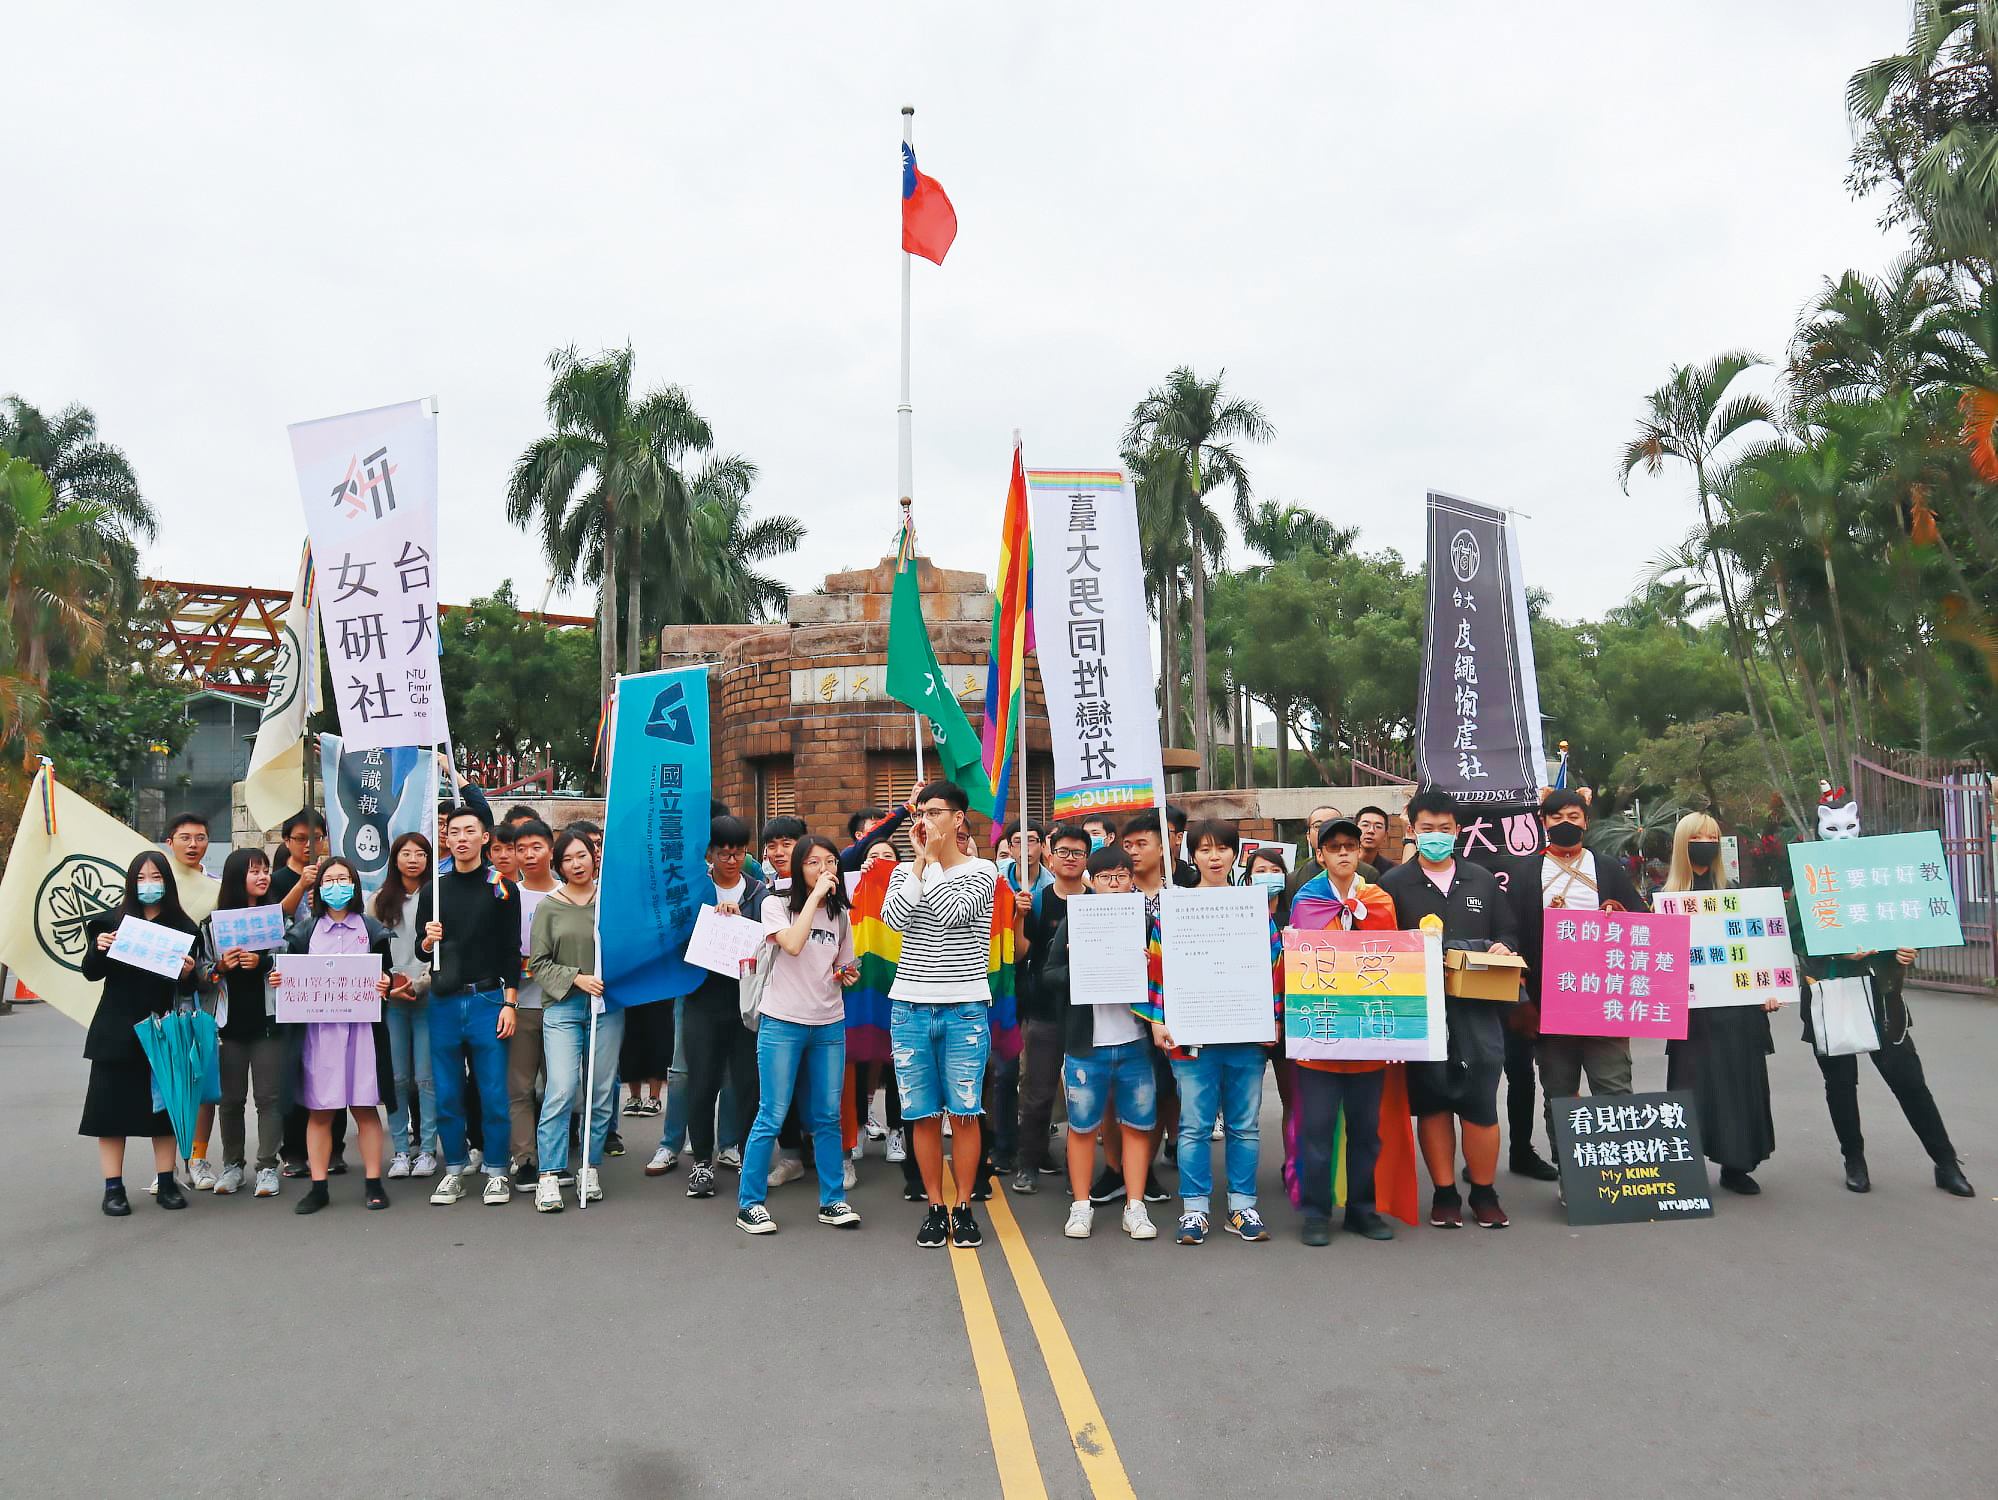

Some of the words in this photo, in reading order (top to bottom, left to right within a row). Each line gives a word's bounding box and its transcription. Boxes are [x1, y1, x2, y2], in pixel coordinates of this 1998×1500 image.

[1452, 587, 1477, 613] 台大
[328, 553, 402, 722] 女研社
[1453, 617, 1489, 782] 皮繩愉虐社
[358, 748, 383, 815] 意識報
[1805, 862, 1943, 895] 性要好好教
[1663, 896, 1737, 914] 什麼癖好
[1811, 896, 1951, 930] 愛要好好做
[1556, 920, 1651, 946] 我的身體
[1728, 919, 1784, 936] 都不怪
[1605, 948, 1675, 973] 我清楚
[1557, 970, 1651, 997] 我的情慾
[1735, 970, 1792, 988] 樣樣來
[1603, 998, 1672, 1023] 我作主
[1568, 1102, 1688, 1136] 看見性少數
[1573, 1136, 1694, 1168] 情慾我作主
[1601, 1169, 1622, 1185] My
[1626, 1167, 1661, 1180] KINK
[1598, 1186, 1620, 1204] My
[1622, 1183, 1677, 1197] RIGHTS
[1658, 1198, 1711, 1212] NTUBDSM
